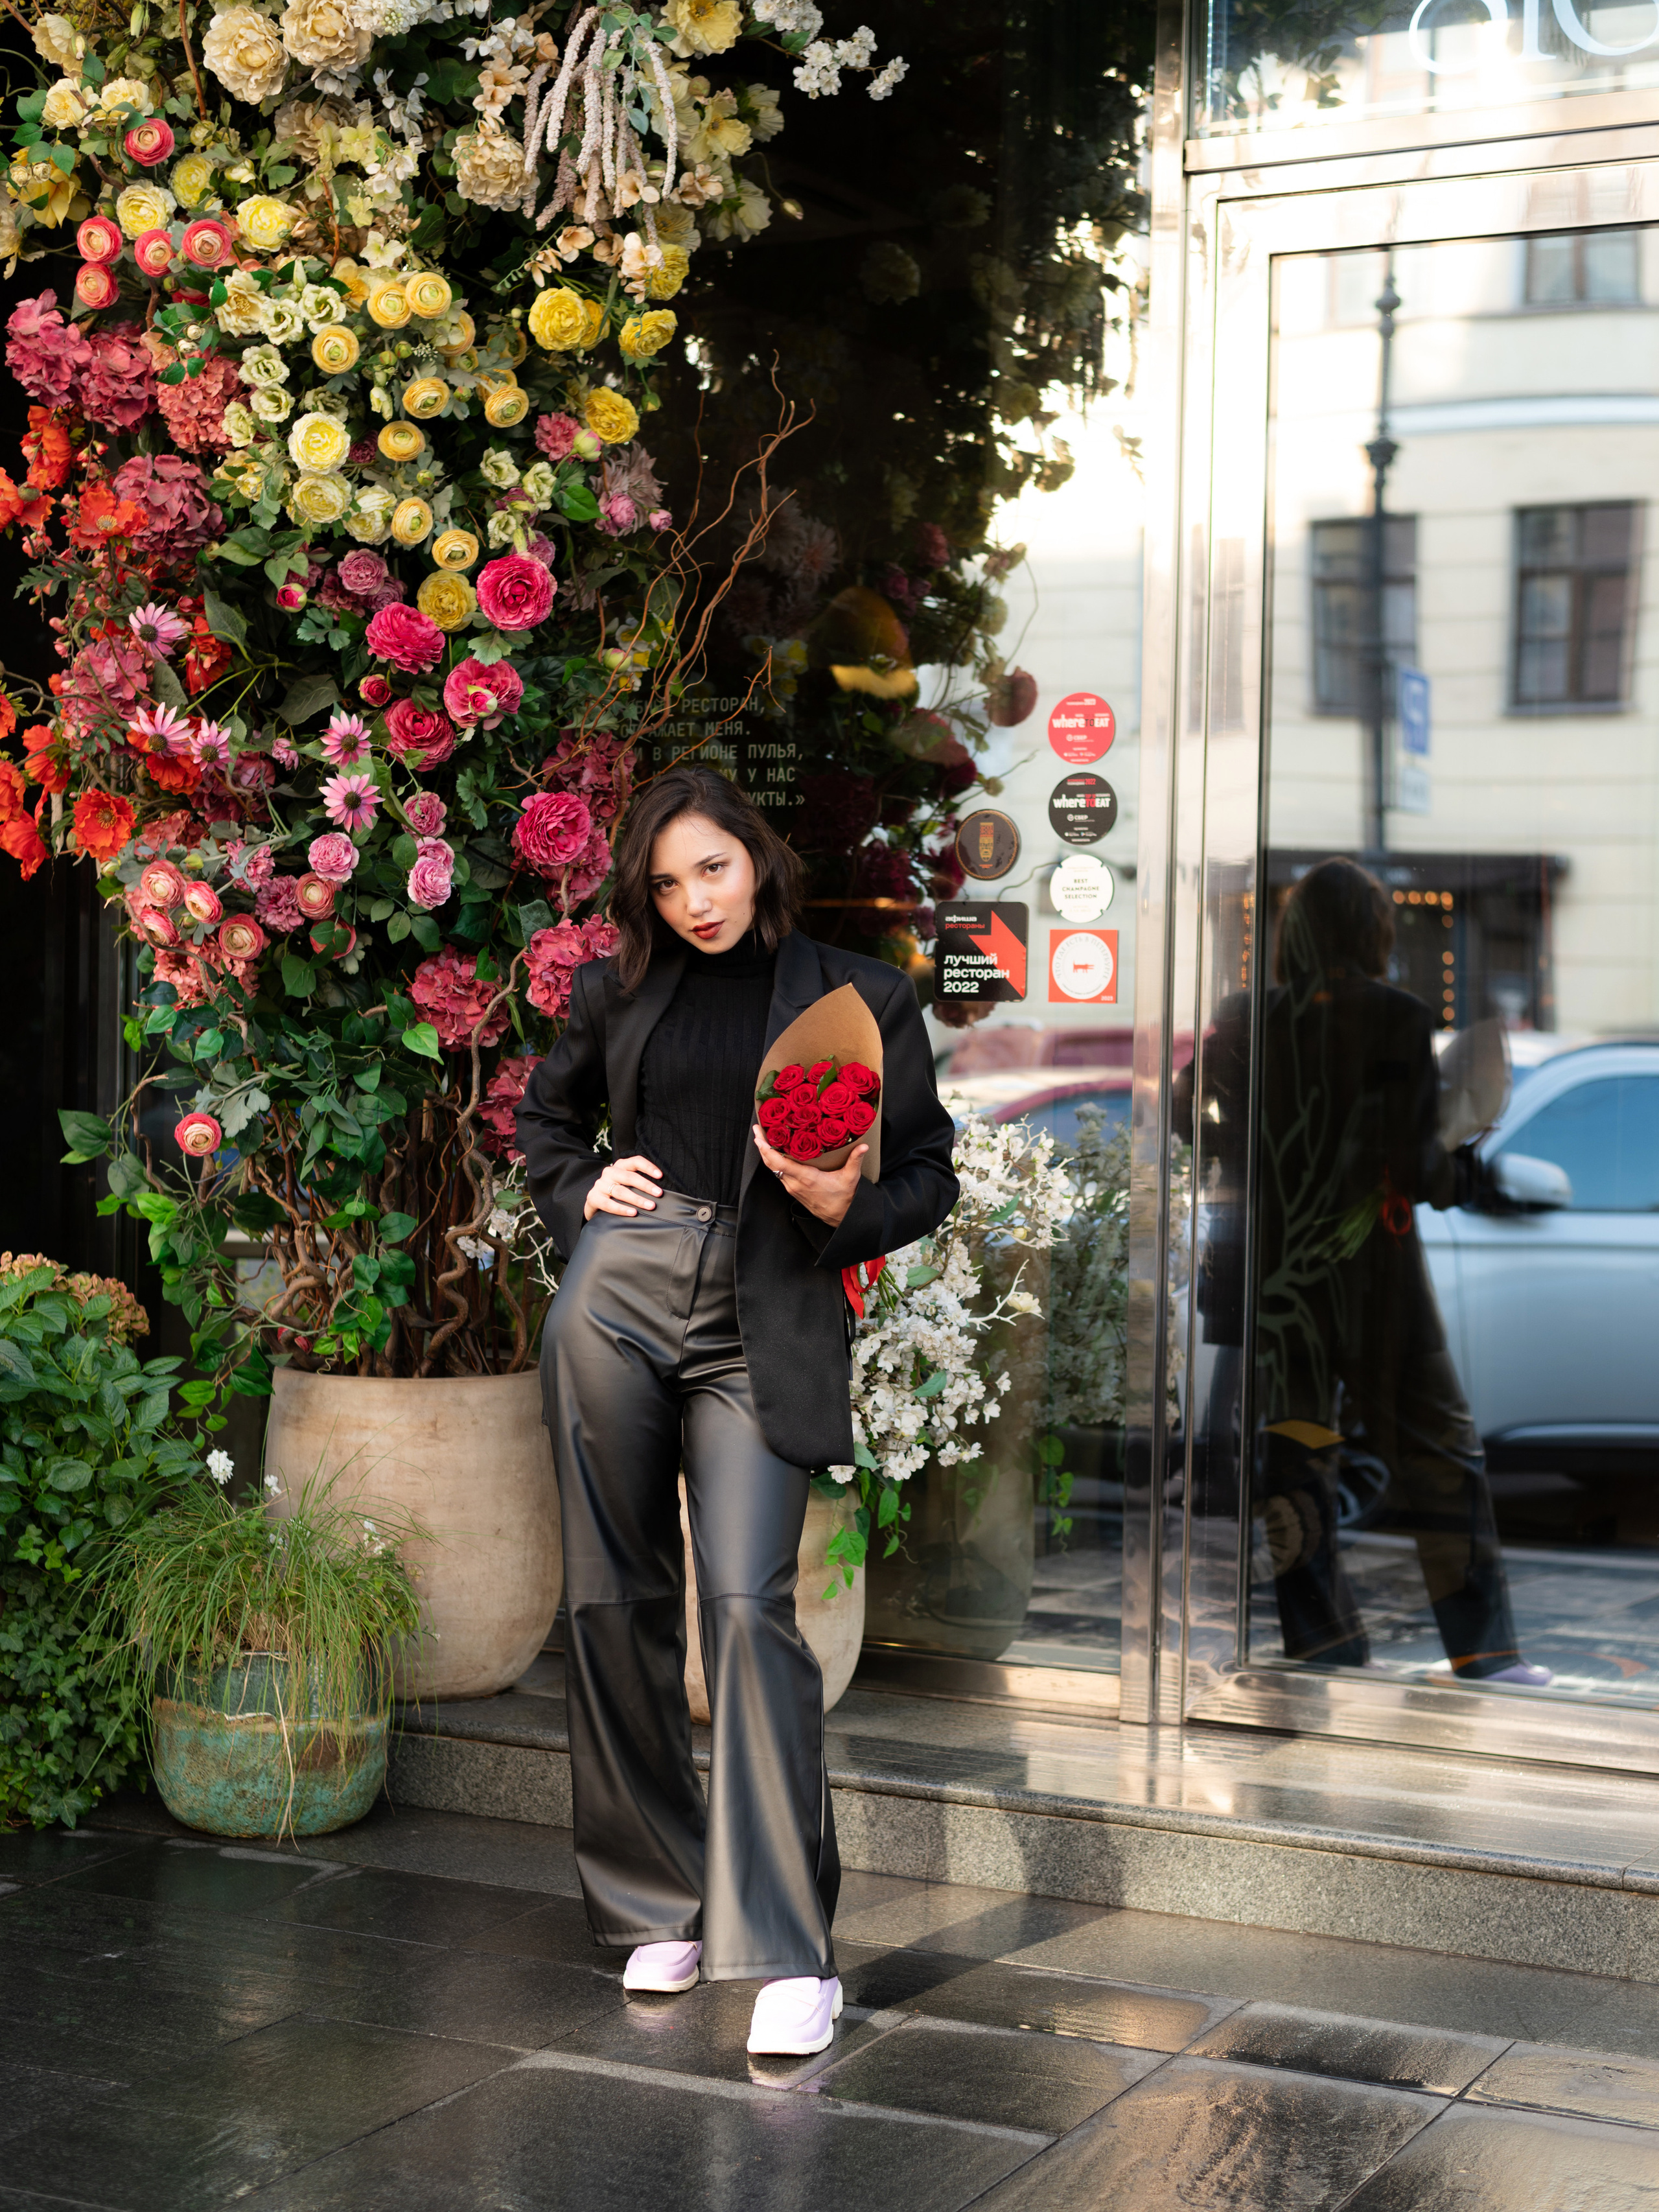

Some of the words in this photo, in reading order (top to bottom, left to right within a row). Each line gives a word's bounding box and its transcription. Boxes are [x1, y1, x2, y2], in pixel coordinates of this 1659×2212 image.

[682, 697, 765, 714] РЕСТОРАН,
[705, 721, 750, 736] МЕНЯ.
[653, 746, 662, 760] В
[748, 743, 803, 761] ПУЛЬЯ,
[748, 769, 757, 782] У
[767, 767, 795, 782] НАС
[945, 914, 977, 923] афиша
[1066, 936, 1084, 948] ЕСТЬ
[944, 953, 998, 967] лучший
[944, 968, 1010, 980] ресторан
[944, 981, 979, 993] 2022
